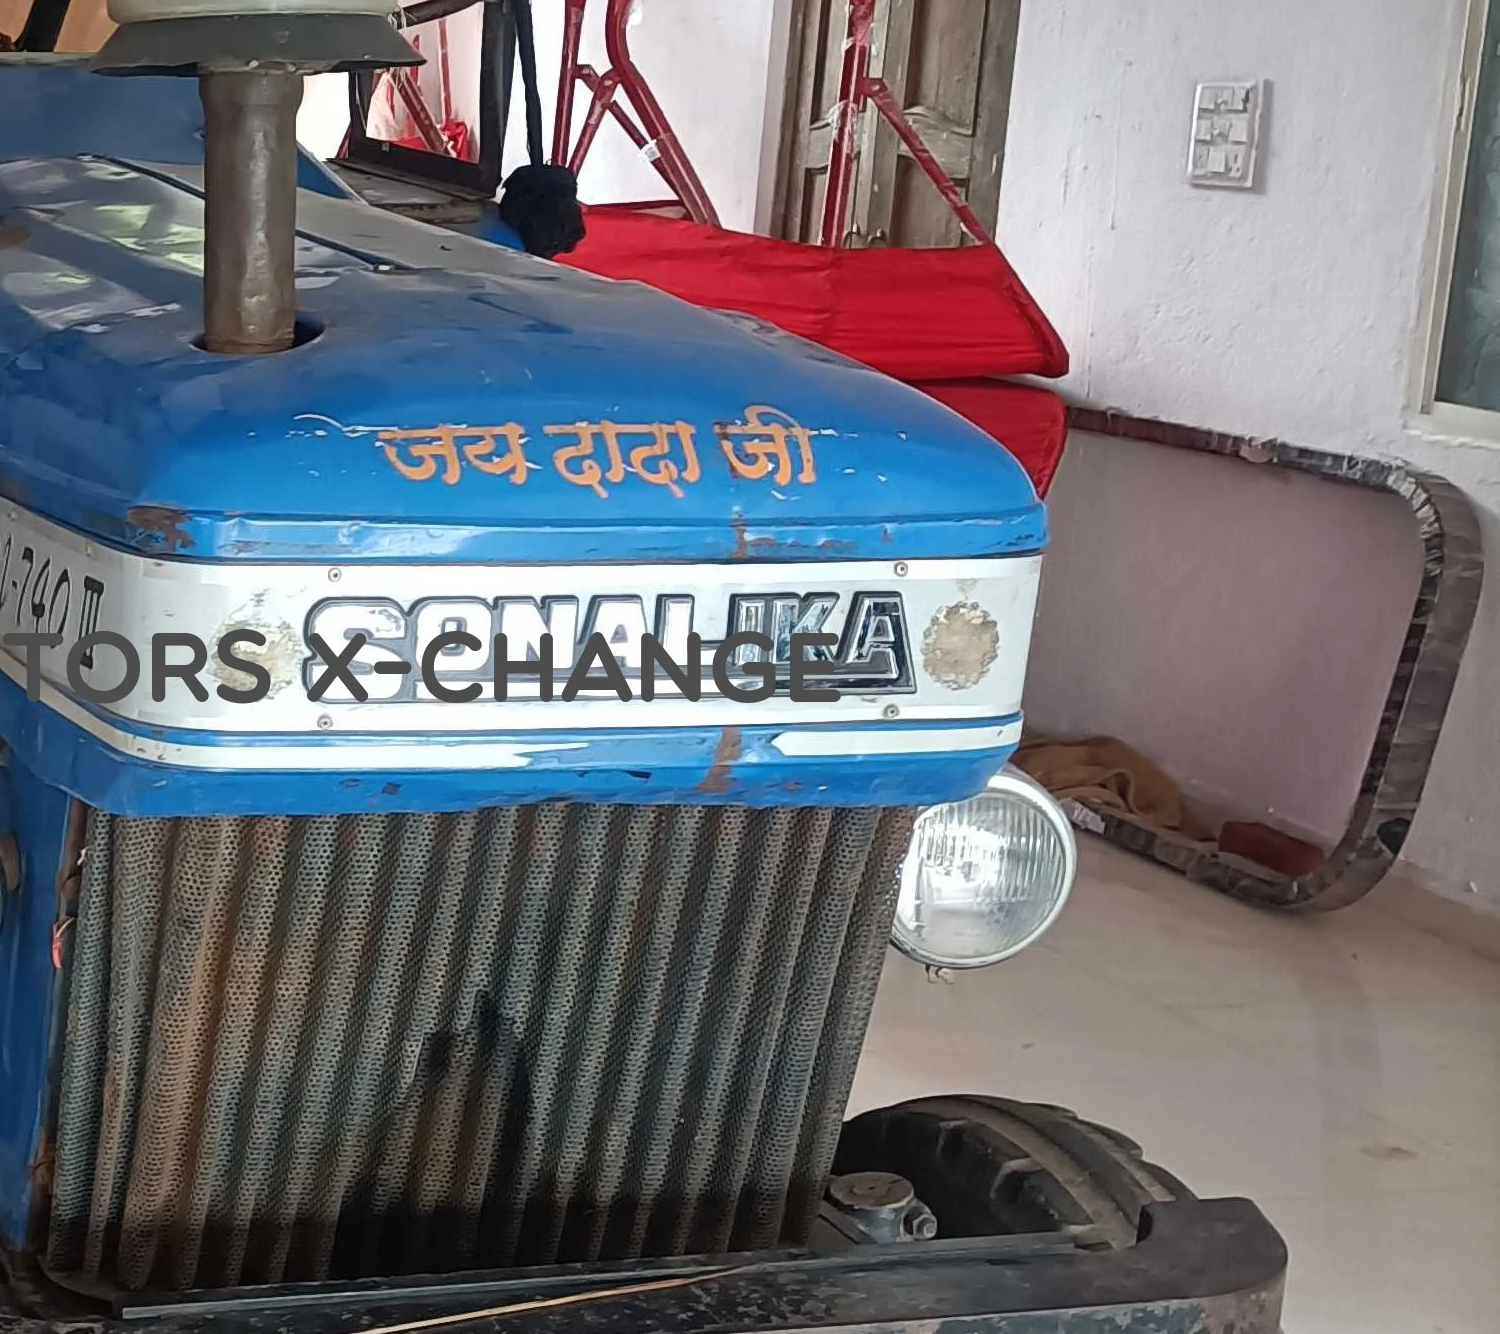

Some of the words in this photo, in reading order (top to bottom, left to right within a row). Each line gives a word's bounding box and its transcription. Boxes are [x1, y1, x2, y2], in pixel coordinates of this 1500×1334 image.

[377, 421, 529, 486] जय
[542, 420, 701, 499] दादा
[712, 404, 818, 486] जी
[303, 593, 917, 704] SONALIKA
